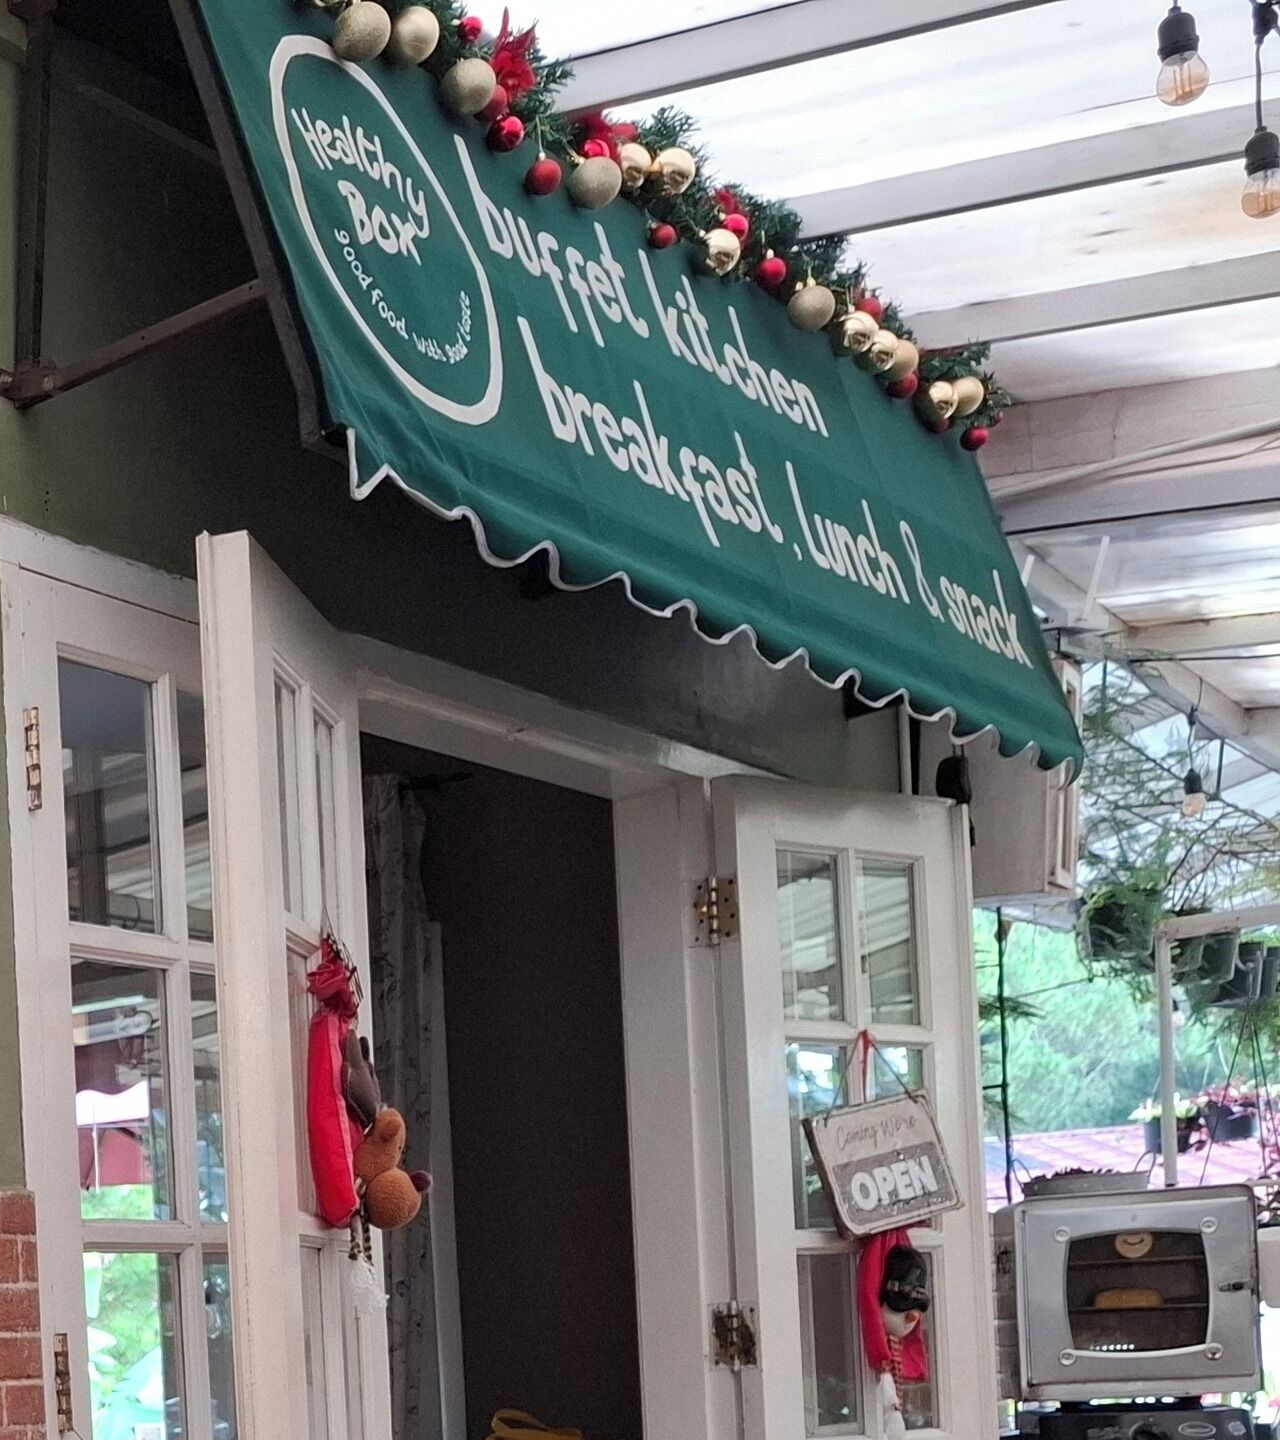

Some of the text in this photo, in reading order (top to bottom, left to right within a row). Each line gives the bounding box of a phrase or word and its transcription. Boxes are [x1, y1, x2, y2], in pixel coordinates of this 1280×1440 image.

[291, 107, 429, 239] Healthy
[334, 228, 373, 290] good
[453, 133, 829, 437] buffet kitchen
[940, 569, 1034, 670] snack
[851, 1154, 938, 1212] OPEN
